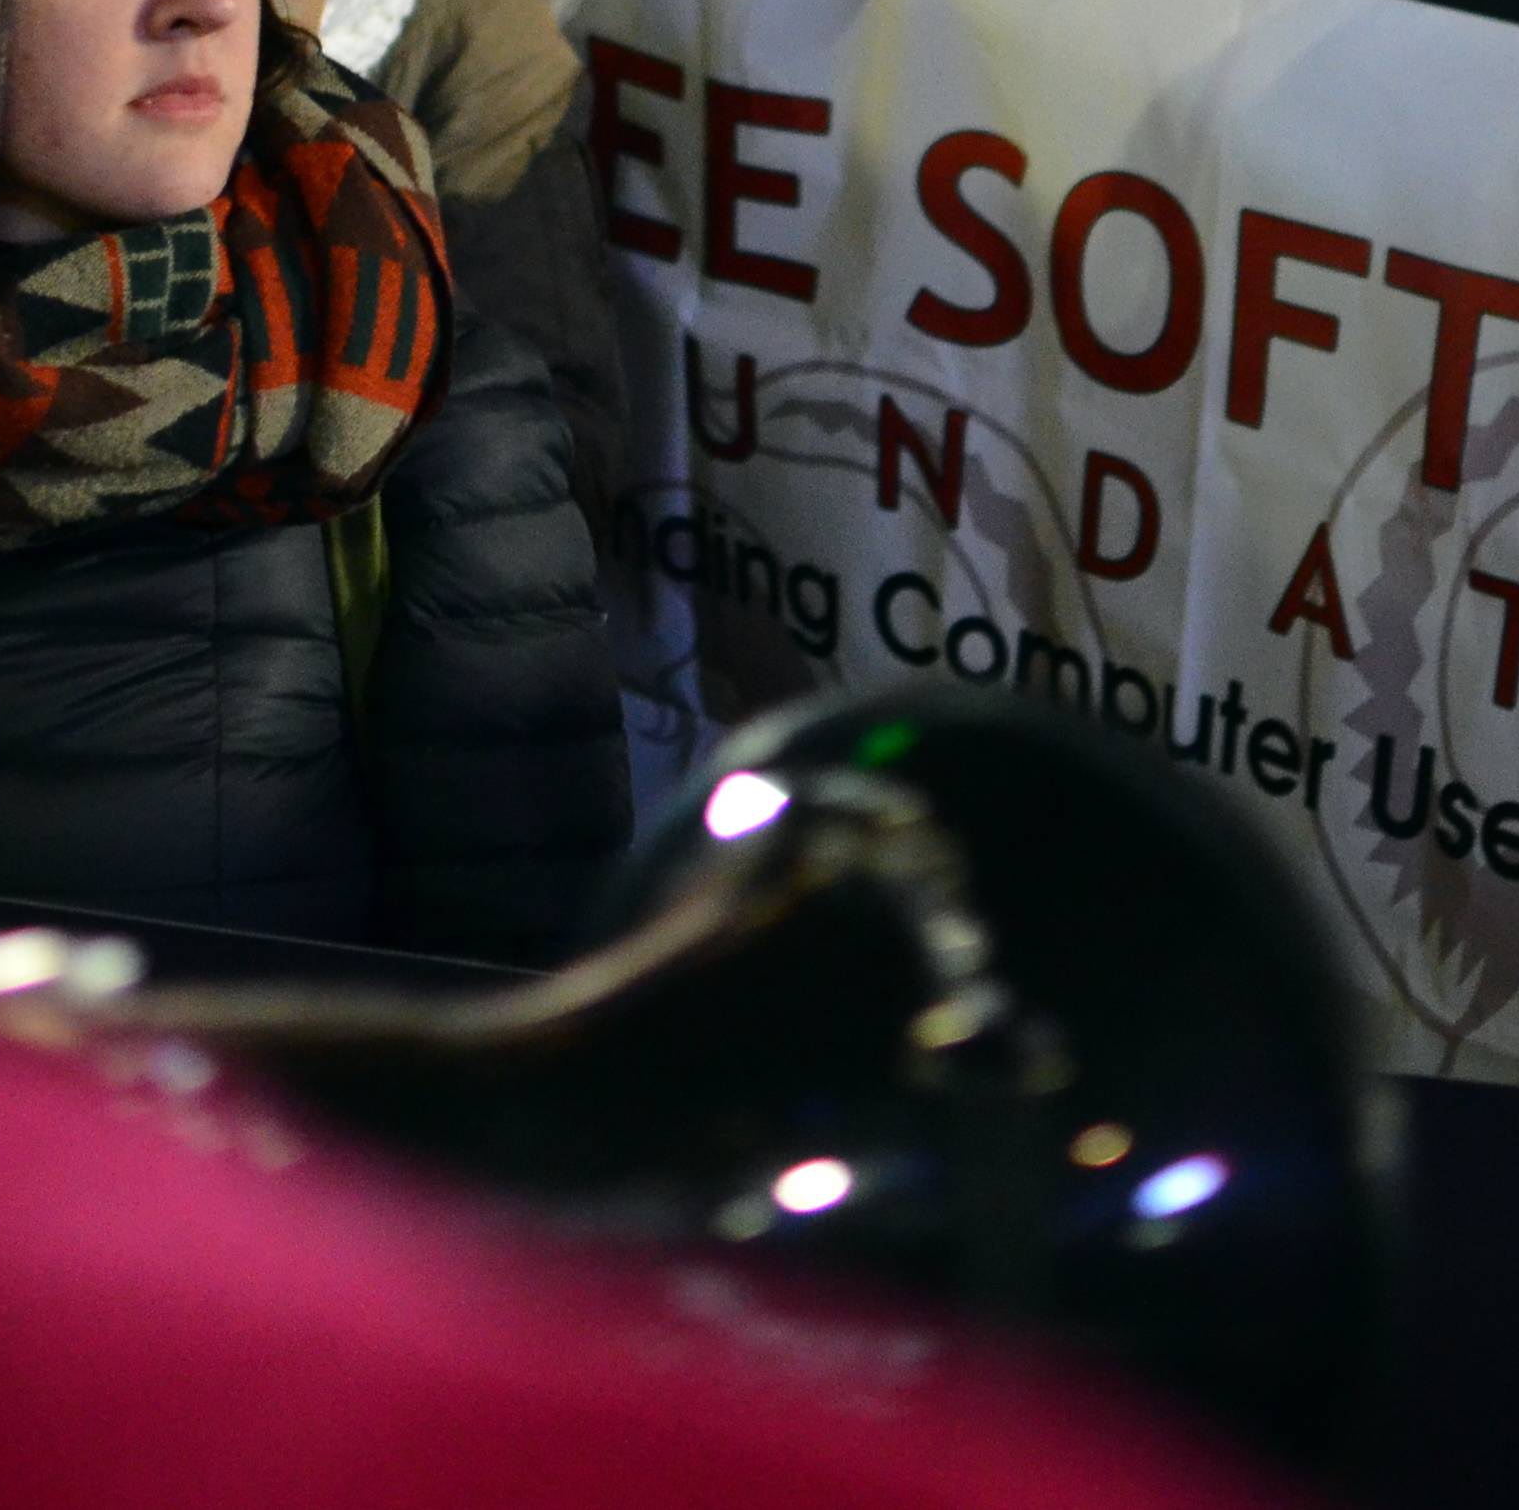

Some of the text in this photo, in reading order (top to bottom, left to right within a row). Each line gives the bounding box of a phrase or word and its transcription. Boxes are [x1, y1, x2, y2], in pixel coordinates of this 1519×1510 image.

[587, 33, 832, 304] EE
[610, 494, 839, 659] nding
[874, 571, 1337, 813] Computer
